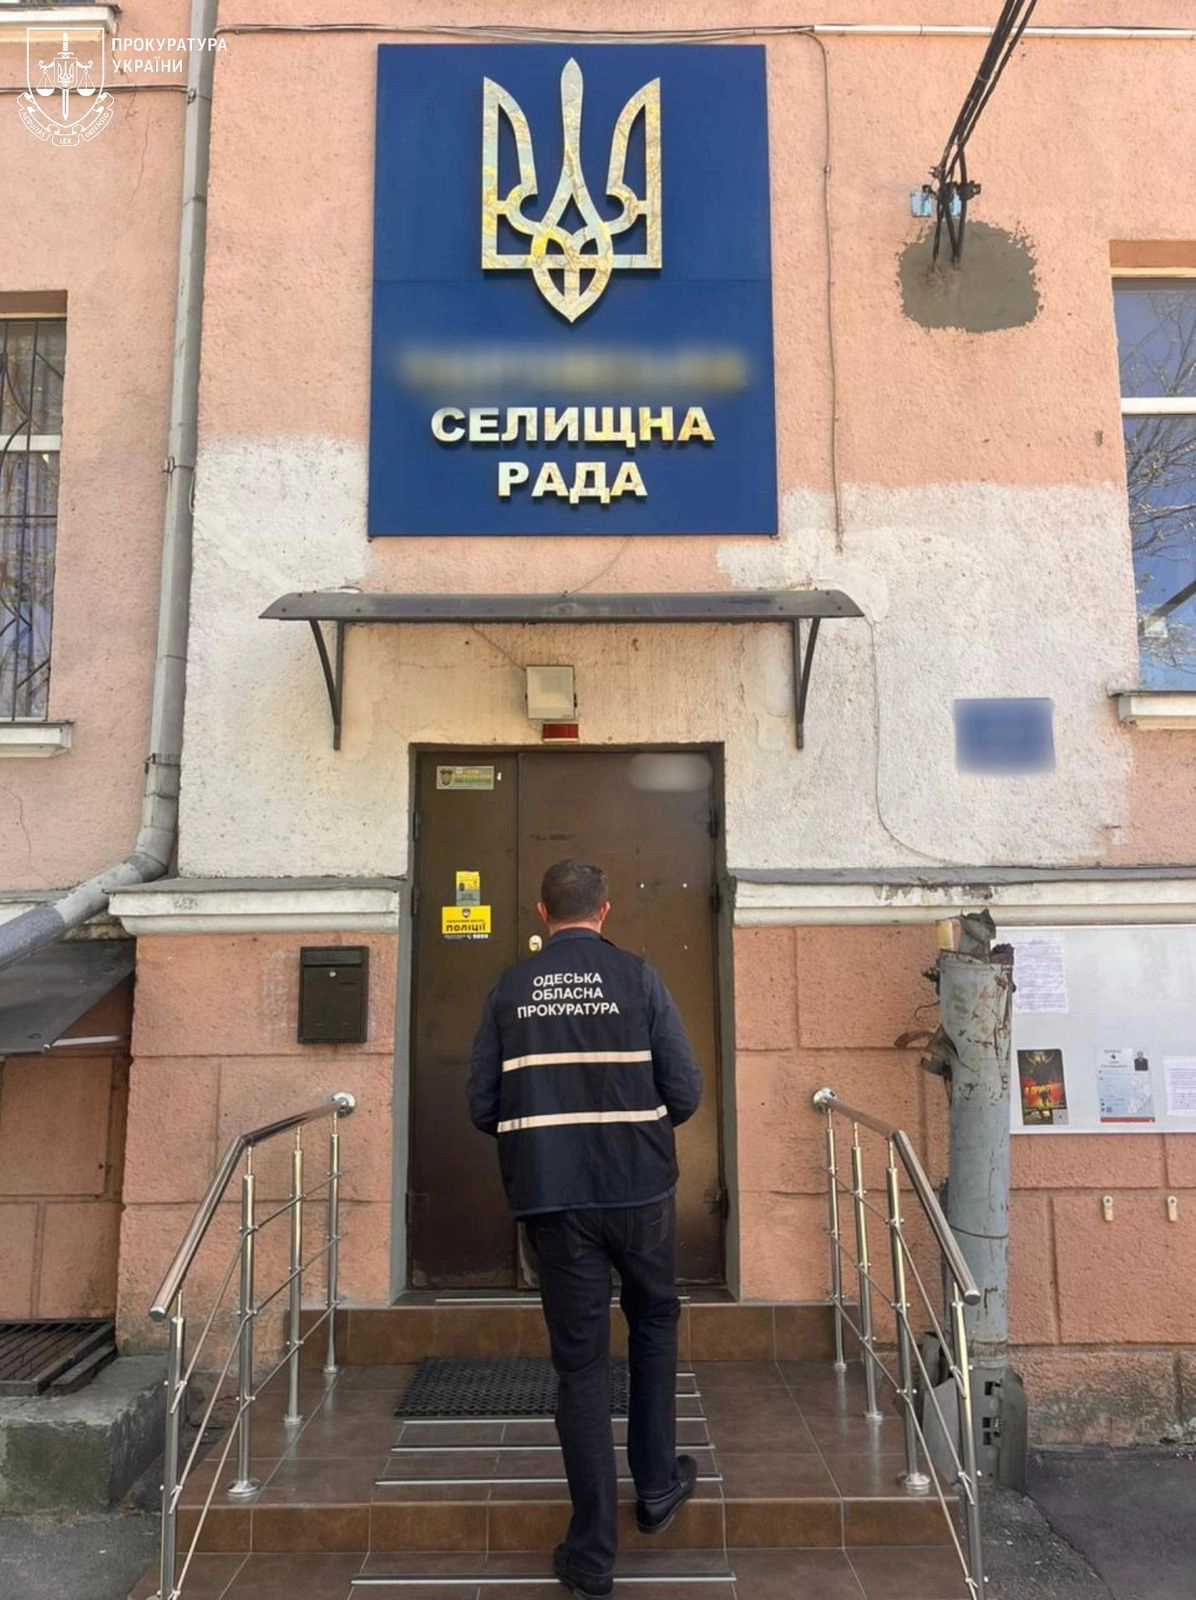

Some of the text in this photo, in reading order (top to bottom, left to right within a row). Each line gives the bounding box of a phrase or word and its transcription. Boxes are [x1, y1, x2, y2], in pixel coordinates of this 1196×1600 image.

[431, 407, 715, 448] СЕЛИЩНА
[498, 461, 648, 504] РАДА
[533, 973, 603, 987] ОДЕСЬКА
[532, 987, 603, 1001] ОБЛАСНА
[517, 1002, 619, 1019] ПРОКУРАТУРА
